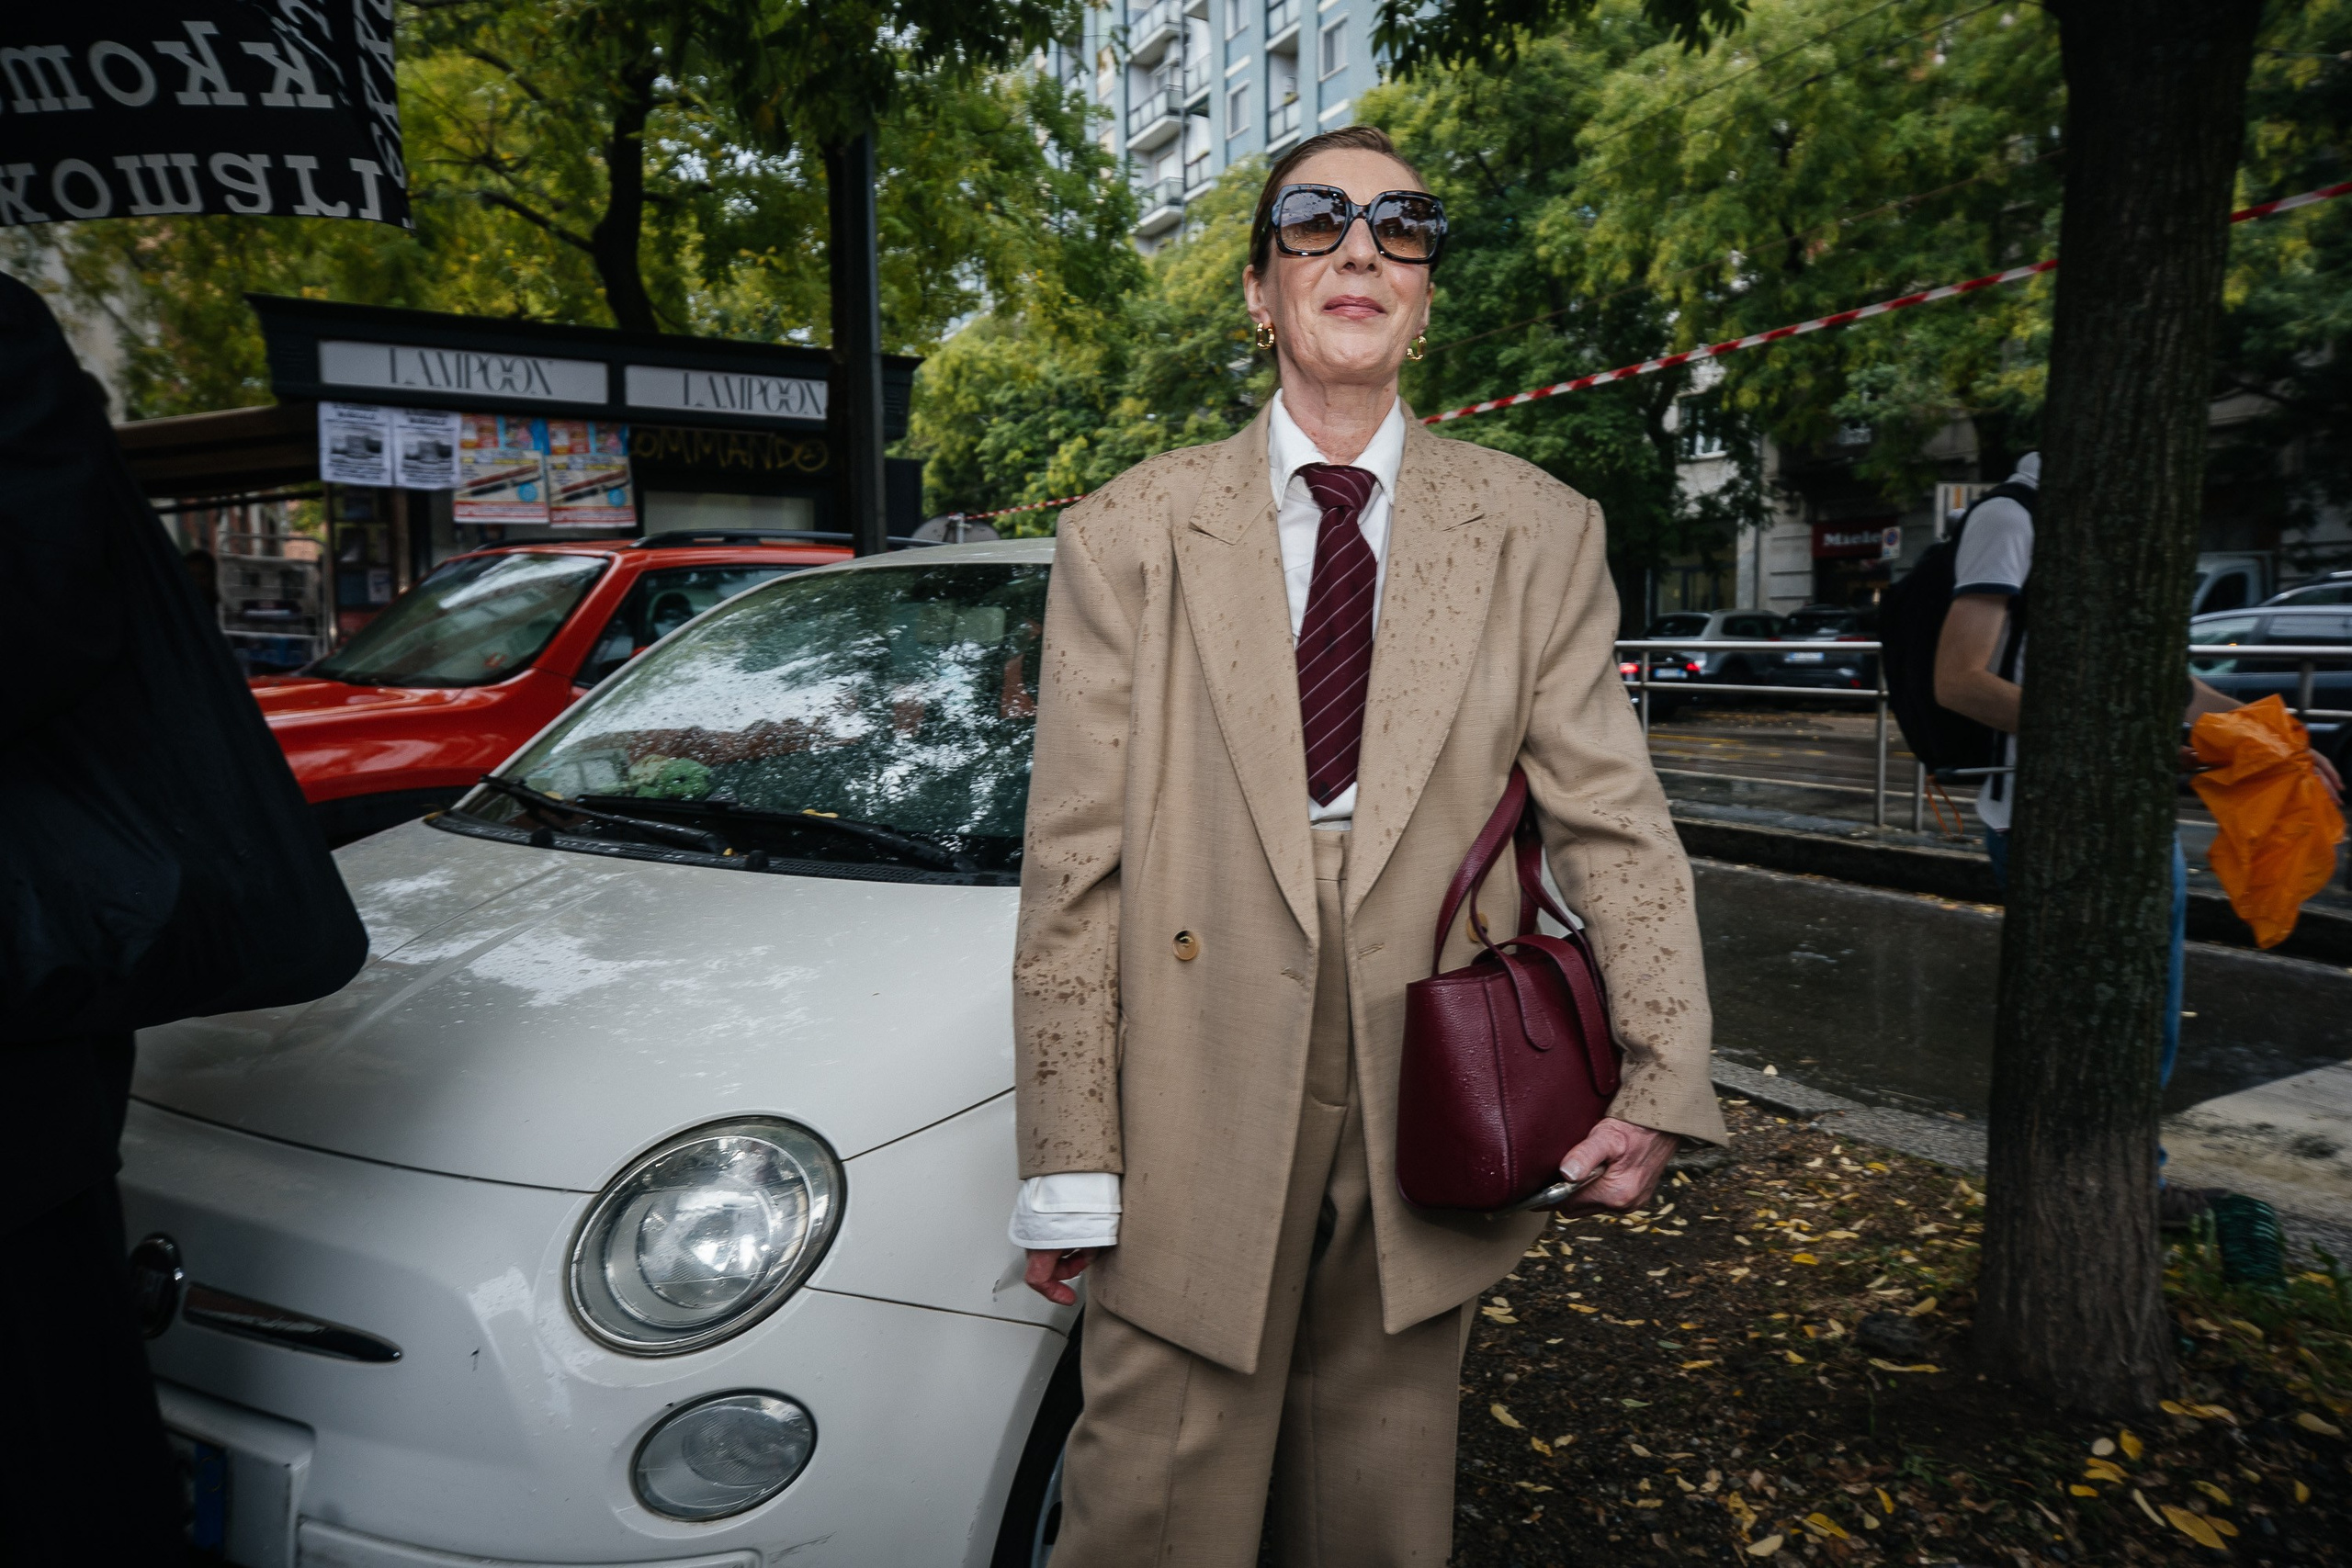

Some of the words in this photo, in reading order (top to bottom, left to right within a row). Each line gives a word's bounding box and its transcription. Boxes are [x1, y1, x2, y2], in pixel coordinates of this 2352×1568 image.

[388, 345, 554, 396] LAMPOON
[682, 371, 825, 415] LAMPOON
[630, 425, 829, 472] OMMANDO
